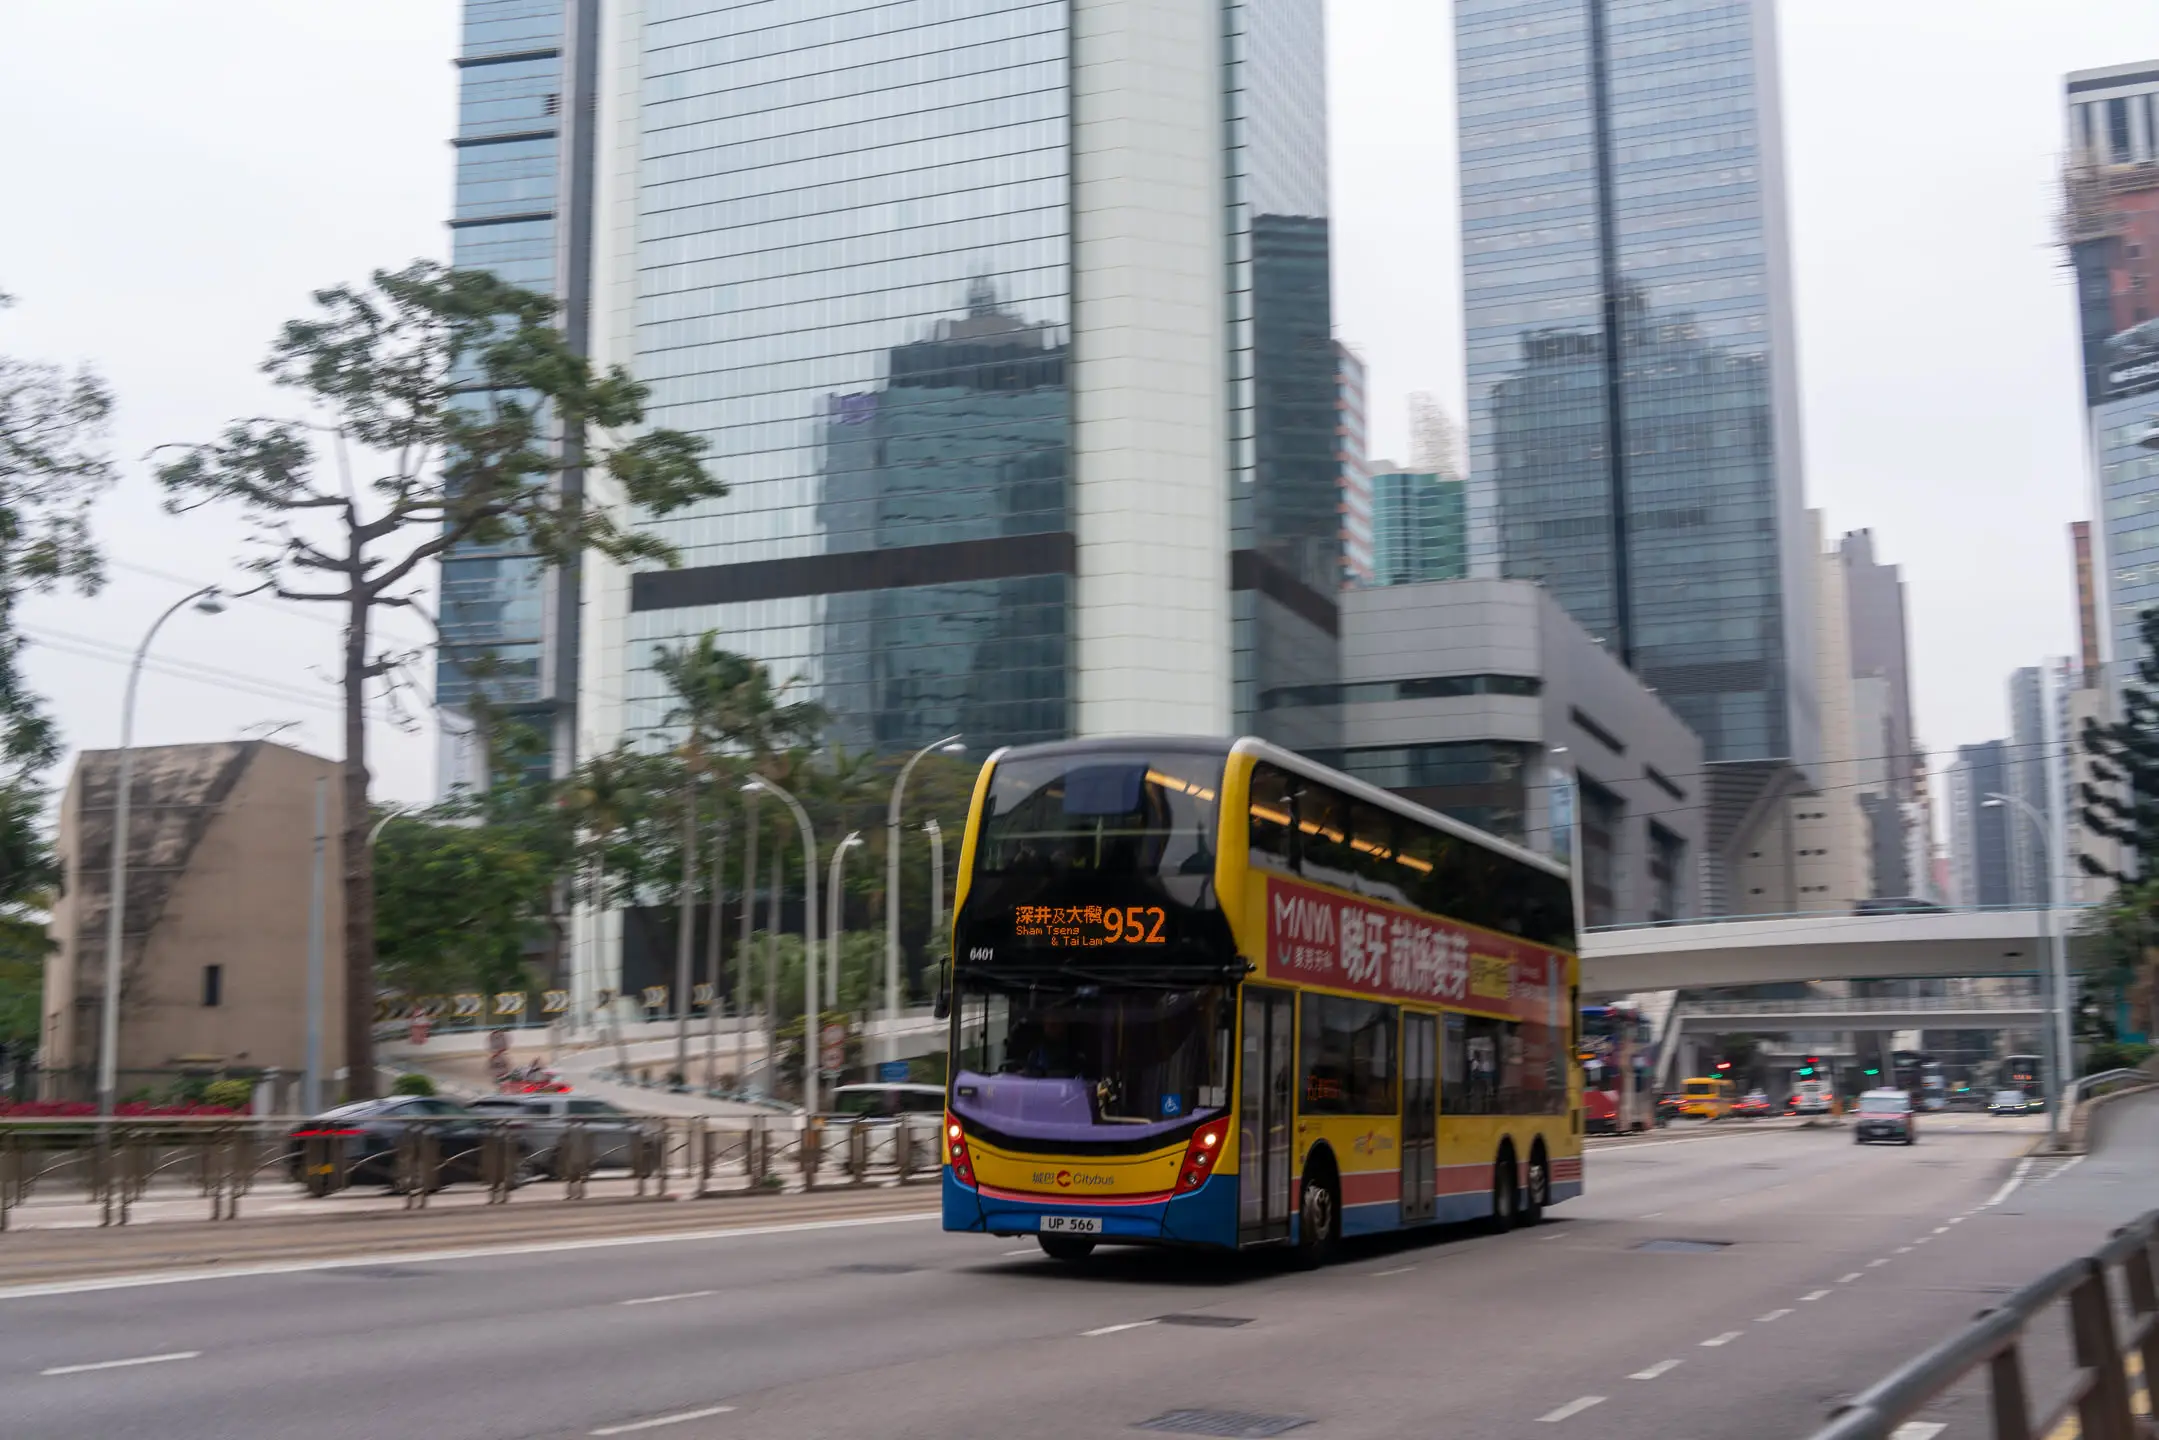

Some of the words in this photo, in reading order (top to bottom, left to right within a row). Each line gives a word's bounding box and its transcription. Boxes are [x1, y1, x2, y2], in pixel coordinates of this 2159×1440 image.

[1016, 926, 1043, 936] Sham
[1046, 926, 1080, 936] Tseng
[1103, 907, 1166, 944] 952
[1051, 936, 1058, 946] &
[1063, 936, 1080, 946] Tai
[1082, 936, 1103, 946] Lam
[969, 946, 994, 961] 6401
[1032, 1172, 1055, 1184] 城巴
[1073, 1172, 1114, 1185] Citybus
[1048, 1218, 1064, 1229] UP
[1069, 1219, 1094, 1231] 566
